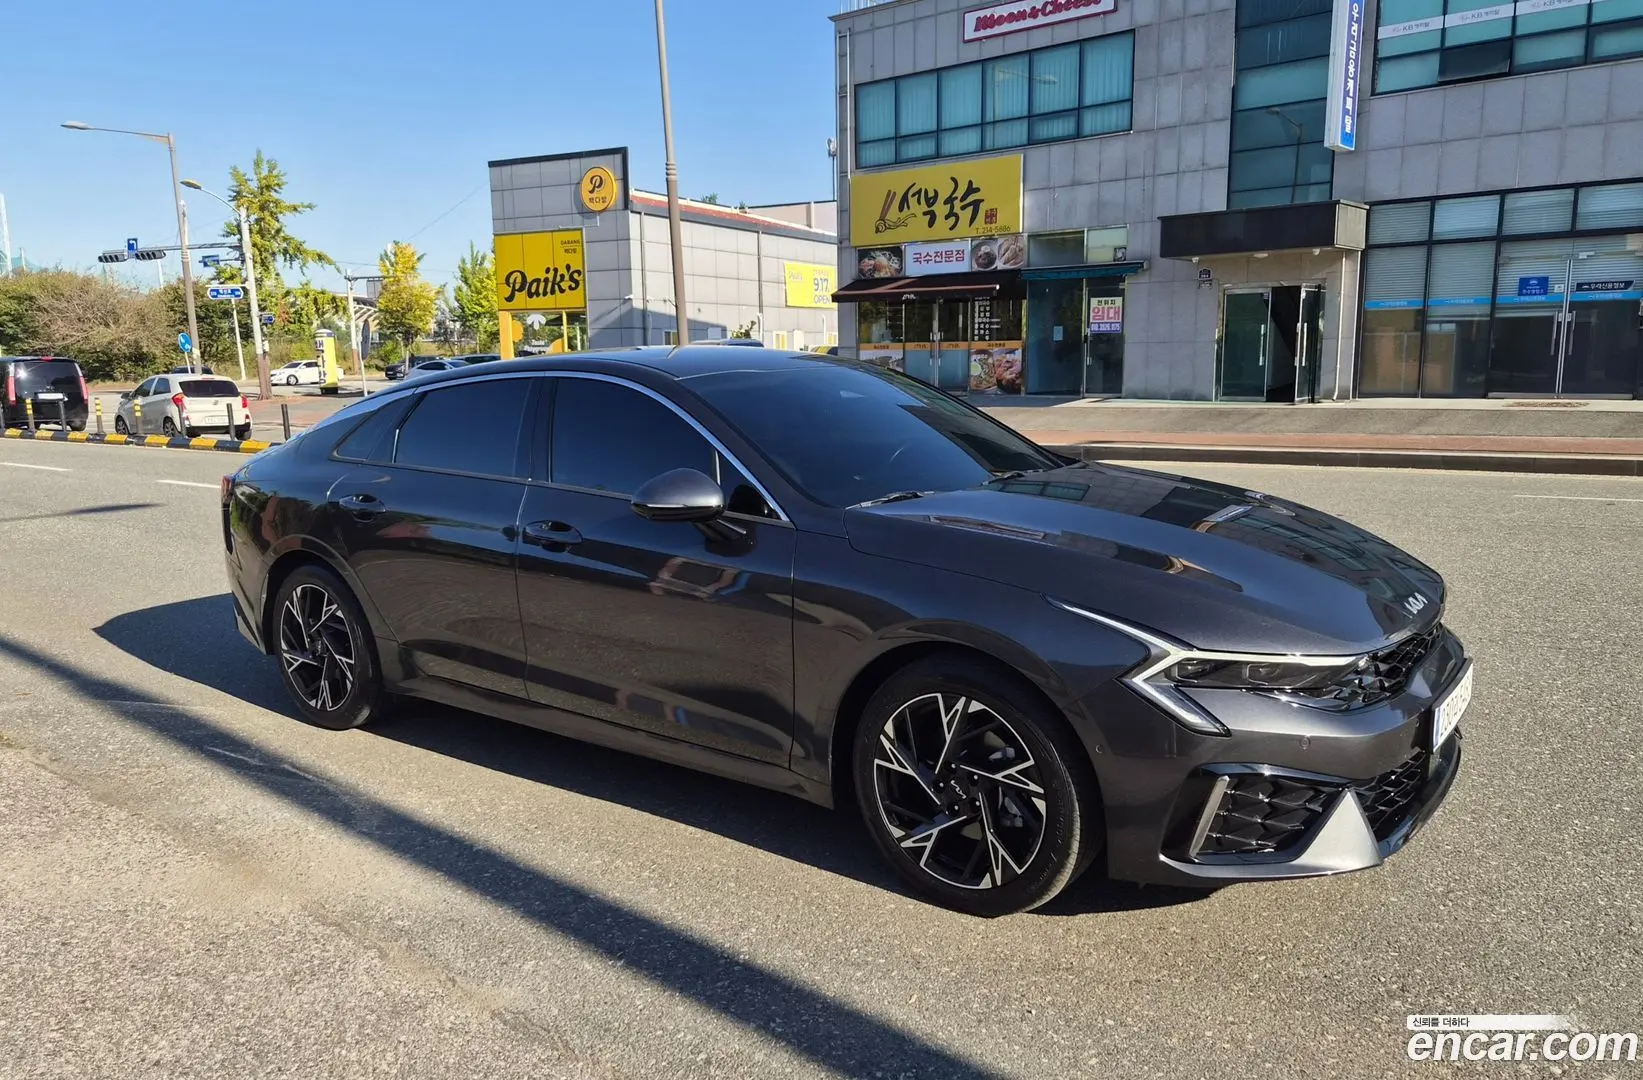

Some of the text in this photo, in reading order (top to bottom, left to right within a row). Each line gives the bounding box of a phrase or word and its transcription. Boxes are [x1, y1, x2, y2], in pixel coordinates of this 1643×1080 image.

[588, 174, 603, 194] P
[912, 249, 965, 265] 국수전문점
[504, 263, 582, 303] Paik's
[814, 294, 831, 304] OPEN
[1091, 306, 1121, 321] 임대
